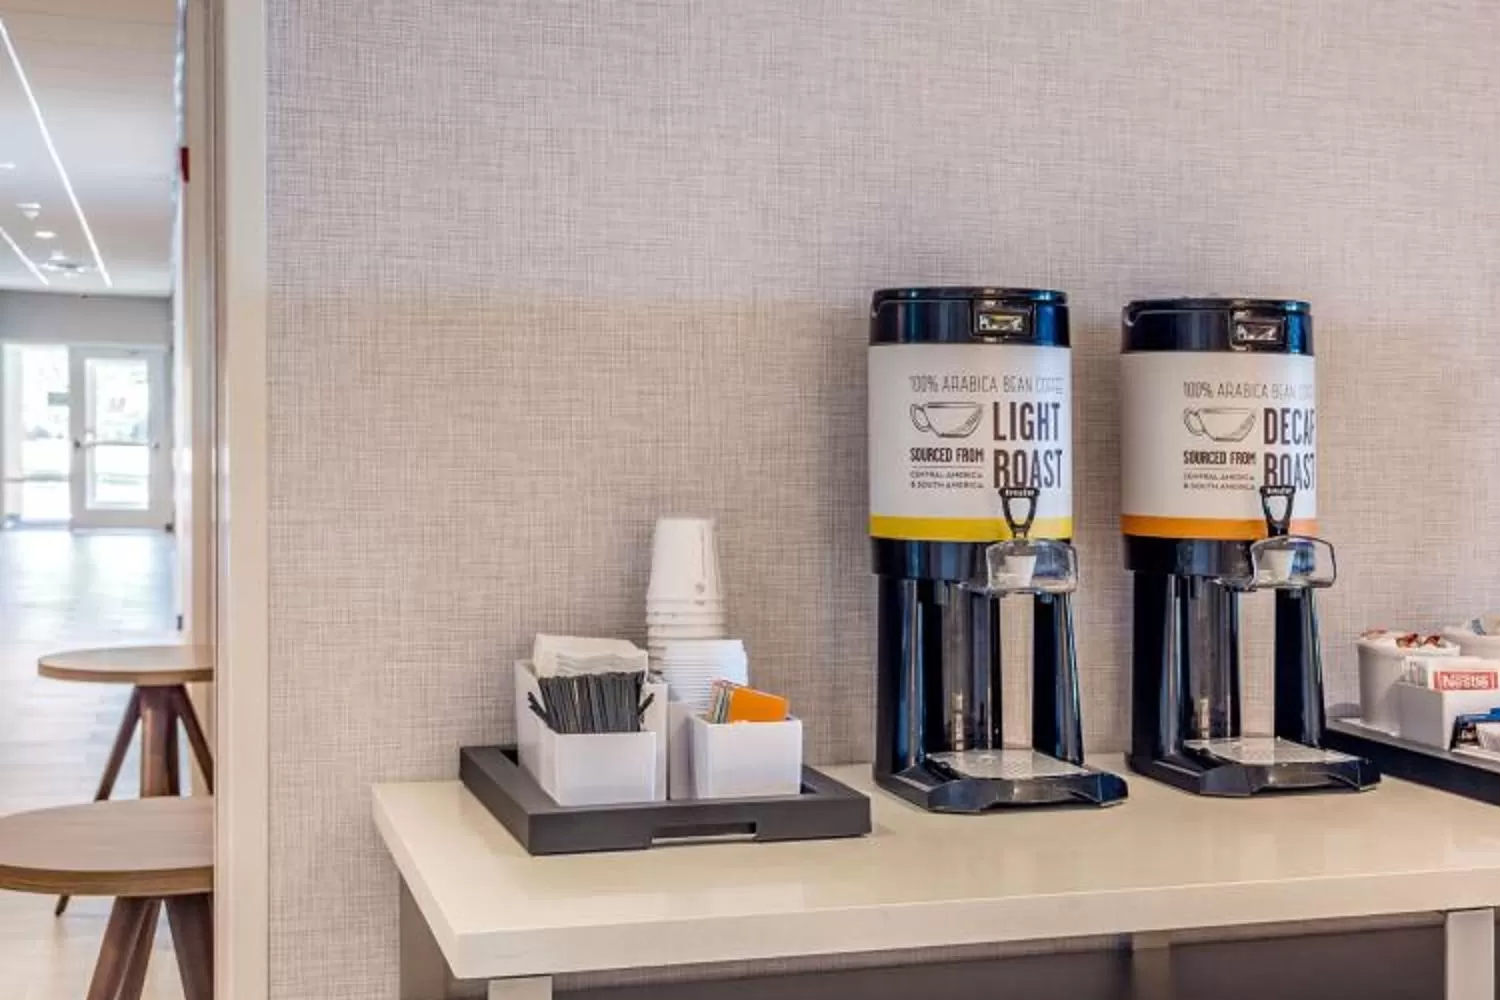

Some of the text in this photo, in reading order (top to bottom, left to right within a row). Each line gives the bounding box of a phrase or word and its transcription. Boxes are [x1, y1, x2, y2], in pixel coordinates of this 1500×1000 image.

[941, 375, 999, 393] ARABICA
[1217, 382, 1269, 399] ARABICA
[993, 401, 1061, 441] LIGHT
[909, 447, 985, 463] SOURCED FROM
[1183, 451, 1257, 465] SOURCED FROM
[993, 449, 1064, 490] ROAST
